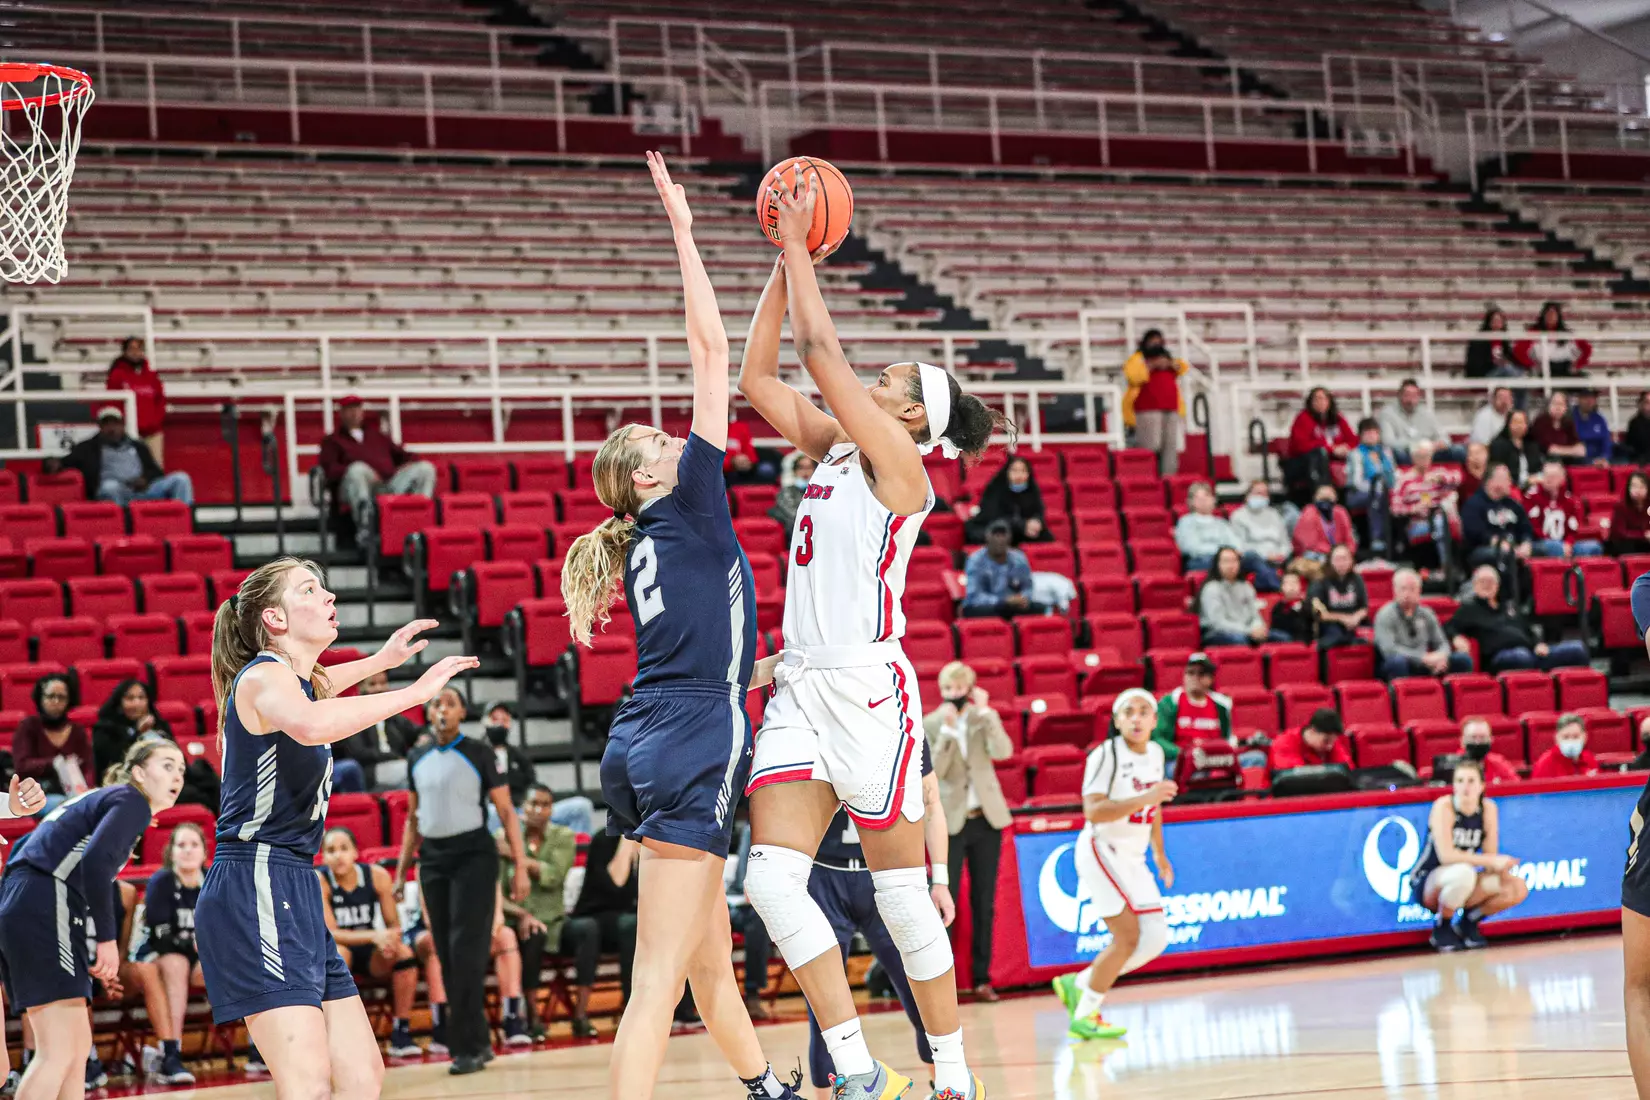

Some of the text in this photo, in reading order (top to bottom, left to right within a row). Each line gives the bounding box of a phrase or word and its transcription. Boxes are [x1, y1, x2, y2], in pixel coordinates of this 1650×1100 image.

[795, 515, 814, 567] 3
[630, 535, 666, 626] 2
[334, 904, 371, 927] YALE
